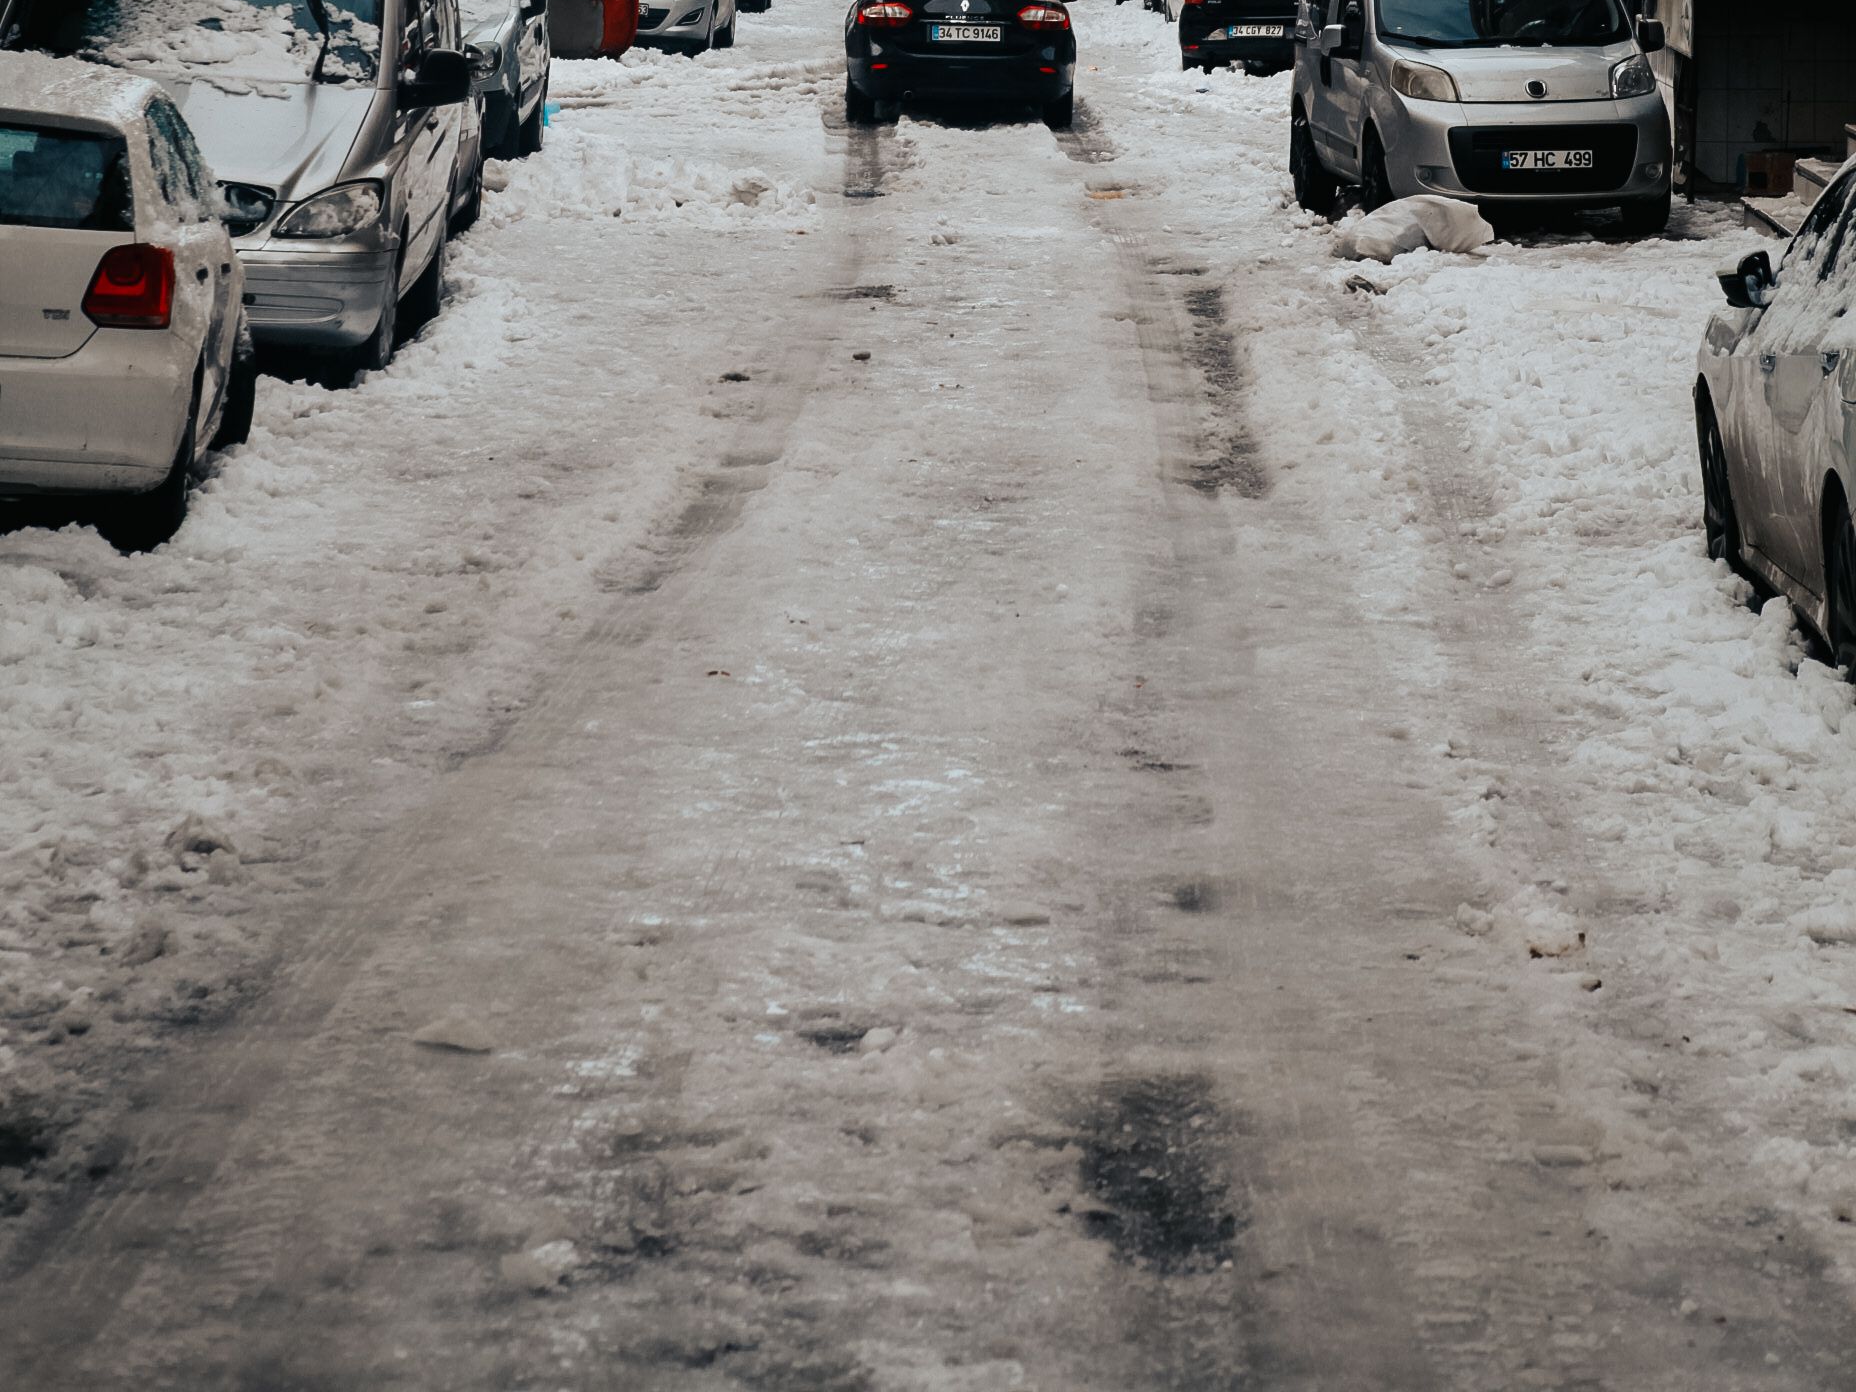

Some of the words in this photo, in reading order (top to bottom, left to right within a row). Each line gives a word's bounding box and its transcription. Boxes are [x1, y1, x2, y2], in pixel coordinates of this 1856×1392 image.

[939, 27, 953, 39] 34
[955, 27, 970, 39] TC
[972, 28, 999, 40] 9146
[1233, 27, 1244, 35] 34
[1245, 27, 1262, 35] CGY
[1265, 26, 1282, 35] 827
[1509, 151, 1529, 168] 57
[1533, 151, 1556, 167] HC
[1563, 151, 1592, 167] 499
